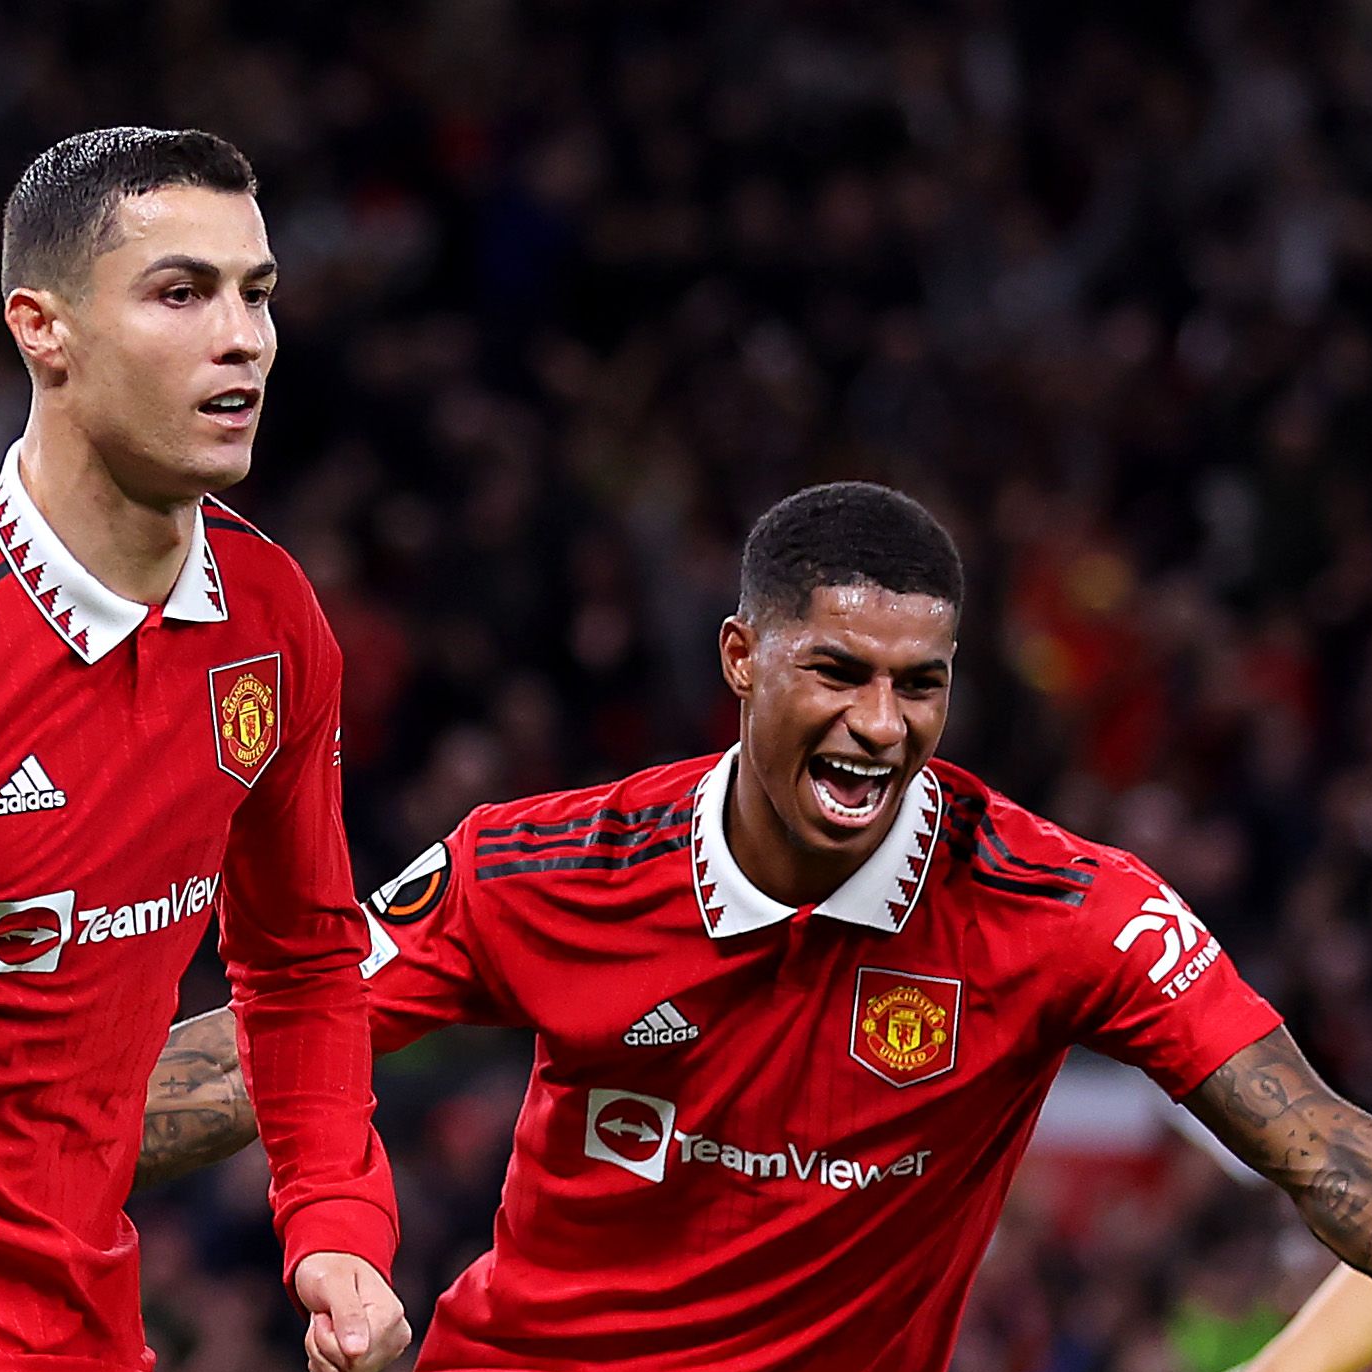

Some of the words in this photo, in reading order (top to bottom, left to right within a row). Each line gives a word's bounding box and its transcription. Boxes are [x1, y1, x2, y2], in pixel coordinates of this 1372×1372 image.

[227, 680, 269, 715] MANCHESTER
[623, 1025, 699, 1046] adidas
[674, 1129, 932, 1190] TeamViewer
